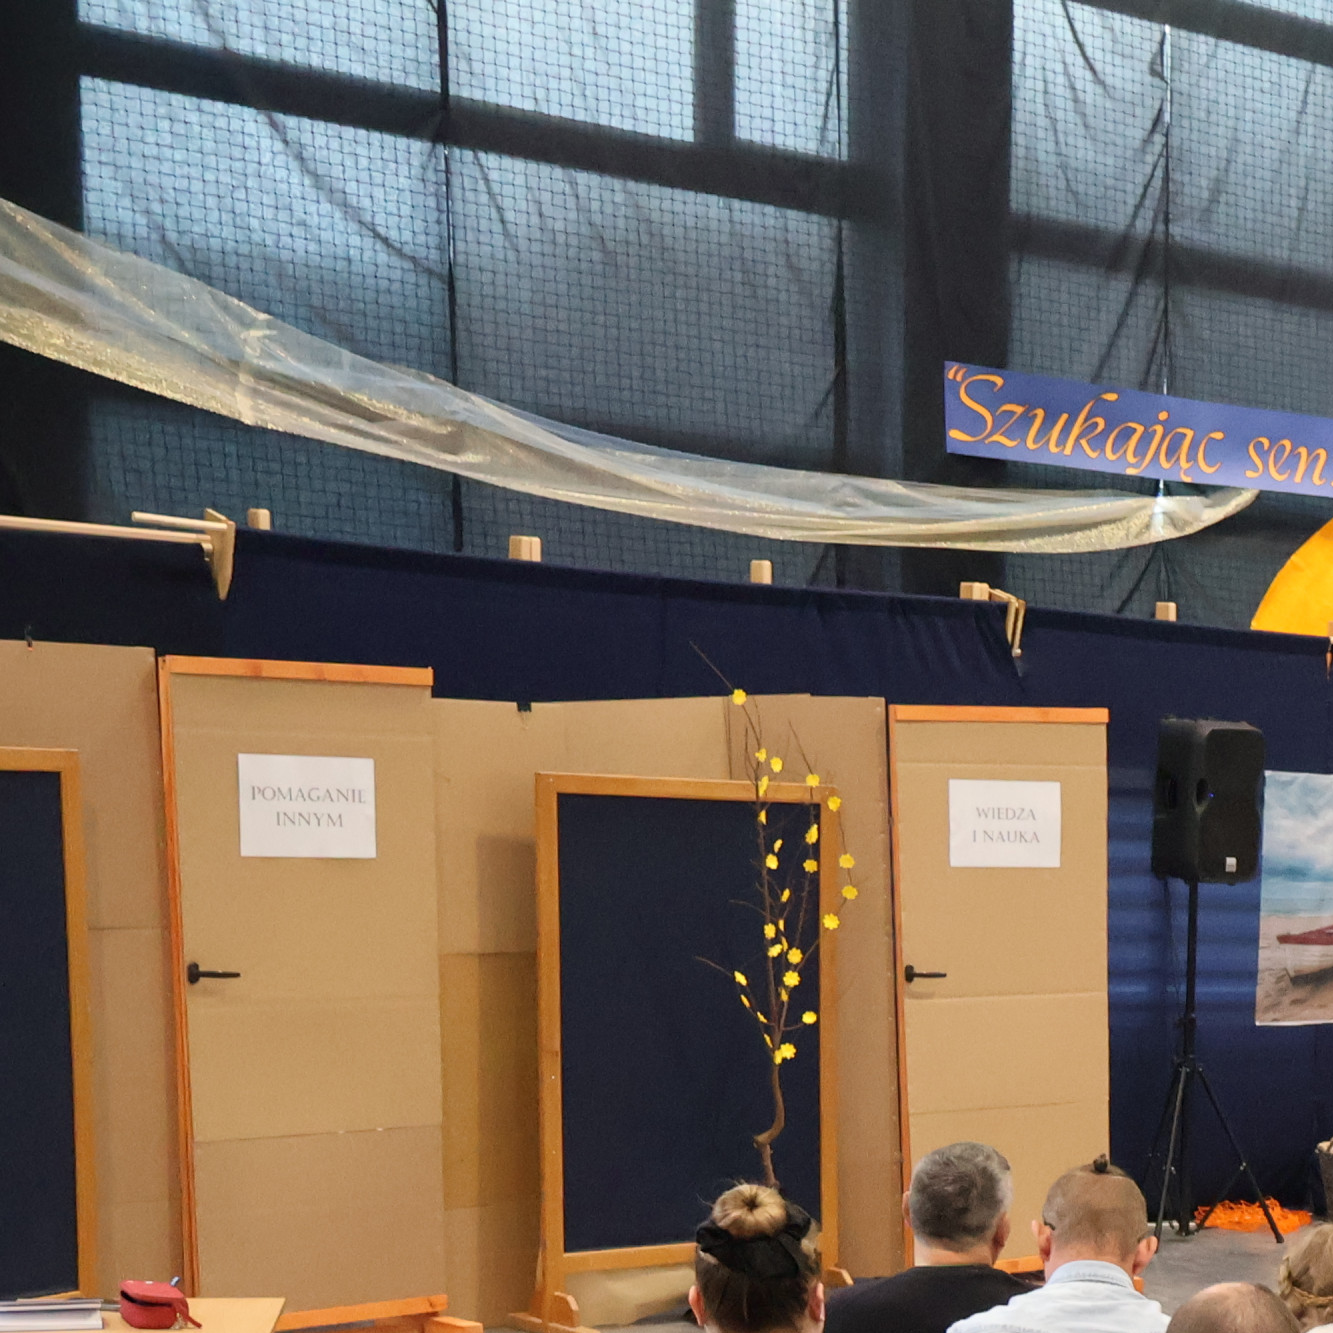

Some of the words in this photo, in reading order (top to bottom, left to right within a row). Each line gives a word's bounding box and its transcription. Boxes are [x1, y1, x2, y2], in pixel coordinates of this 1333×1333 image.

[947, 365, 1226, 483] “Szukając
[251, 785, 366, 804] POMAGANIE
[276, 811, 343, 828] INNYM
[976, 807, 1036, 821] WIEDZA
[972, 829, 977, 844] I
[983, 830, 1040, 844] NAUKA
